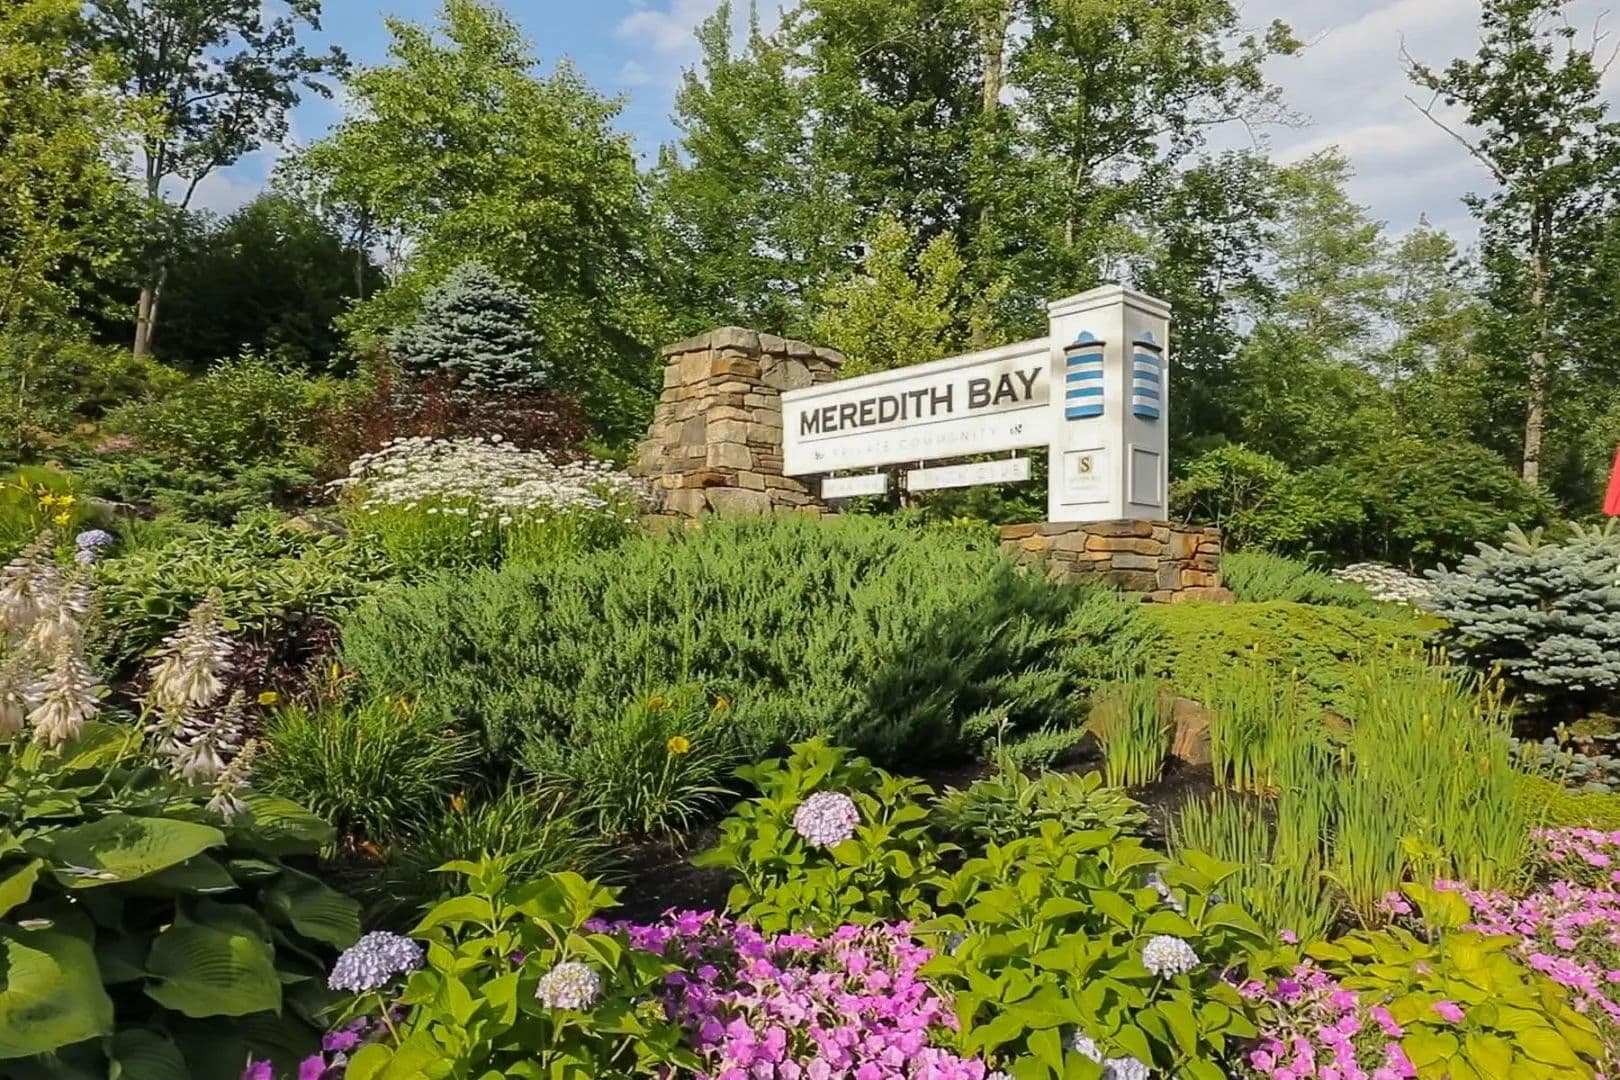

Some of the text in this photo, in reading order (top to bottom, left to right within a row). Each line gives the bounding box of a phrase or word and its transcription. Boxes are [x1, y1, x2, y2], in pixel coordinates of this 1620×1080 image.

[800, 366, 1042, 436] MEREDITH BAY
[1081, 457, 1090, 473] S
